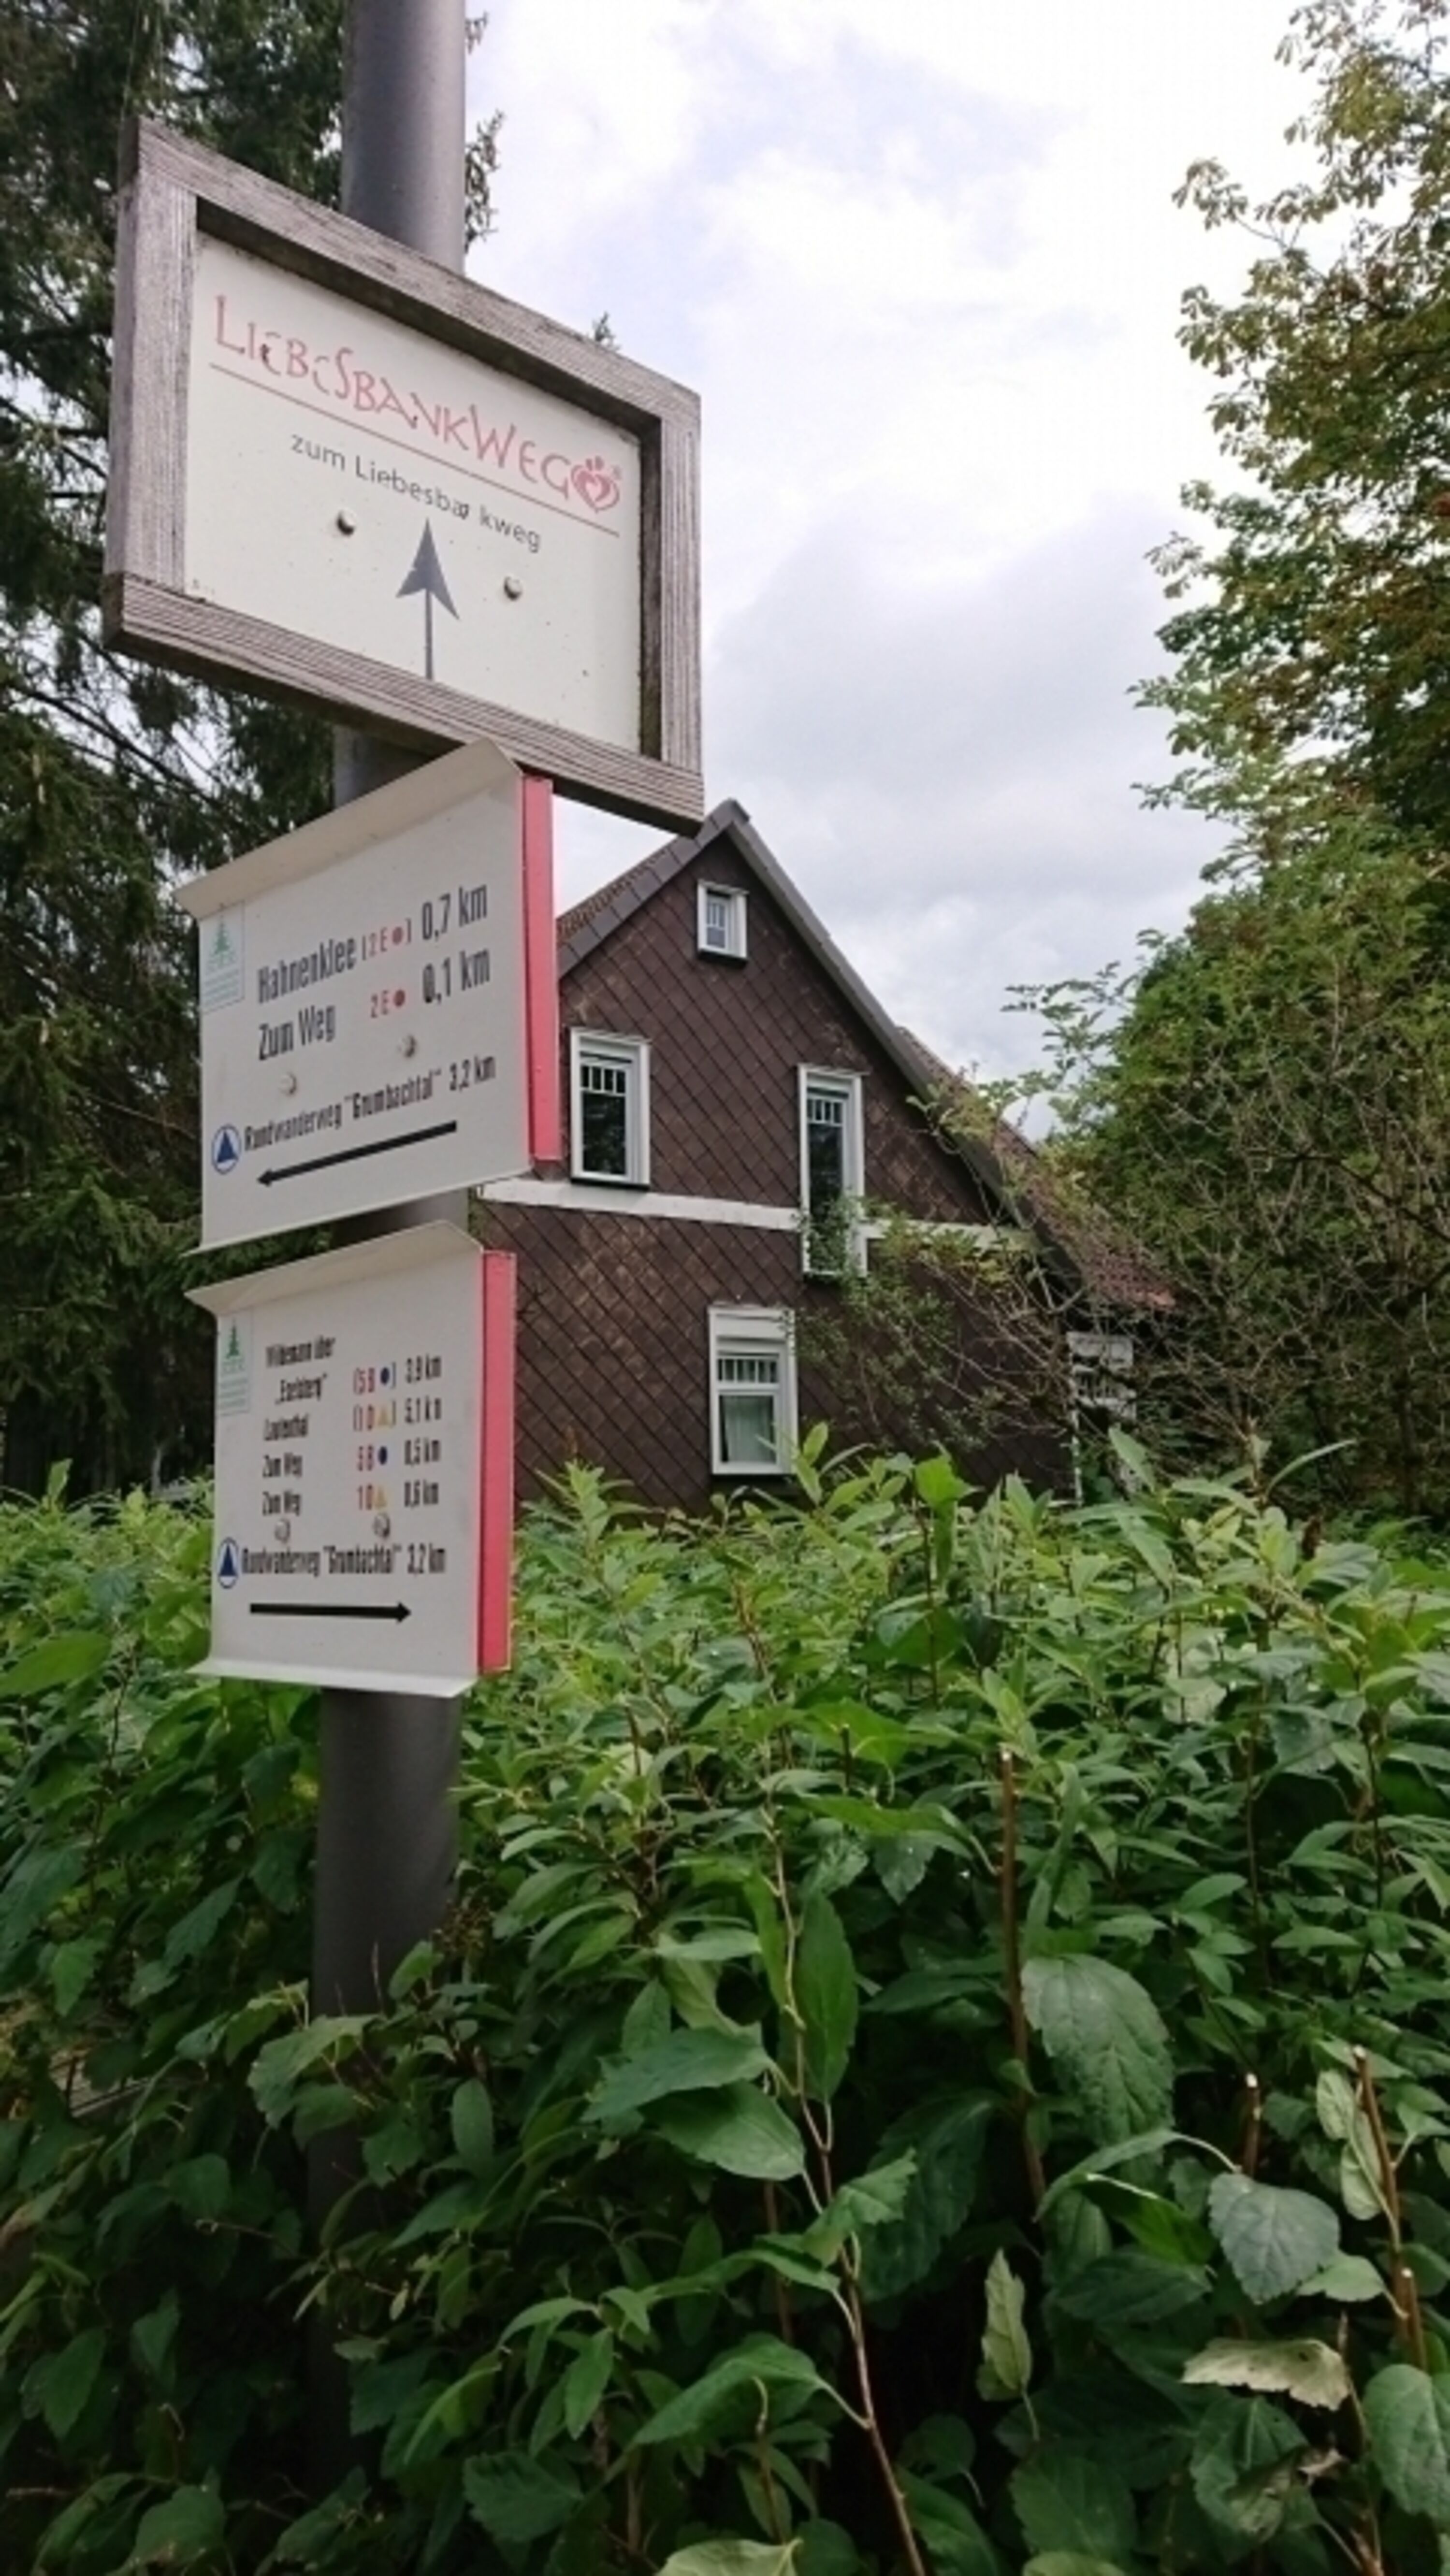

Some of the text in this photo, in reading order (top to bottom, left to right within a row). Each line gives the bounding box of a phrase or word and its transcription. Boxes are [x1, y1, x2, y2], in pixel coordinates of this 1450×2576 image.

[291, 434, 541, 553] zum Liebesbakweg
[257, 936, 356, 1004] Hahnenklee
[421, 893, 451, 940] 0,7
[458, 884, 488, 927] km
[258, 1021, 294, 1061] Zum
[298, 1005, 336, 1046] Weg
[421, 957, 452, 1005] 0,1
[460, 949, 491, 991] km
[244, 1103, 342, 1151] Rundwanderweg
[449, 1063, 471, 1093] 3,2
[474, 1055, 496, 1082] km
[425, 1353, 442, 1379] km
[262, 1454, 281, 1478] Zum
[424, 1438, 440, 1463] km
[262, 1491, 280, 1516] Zum
[422, 1479, 439, 1505] km
[242, 1547, 320, 1577] Rundwanderweg
[428, 1543, 447, 1574] km
